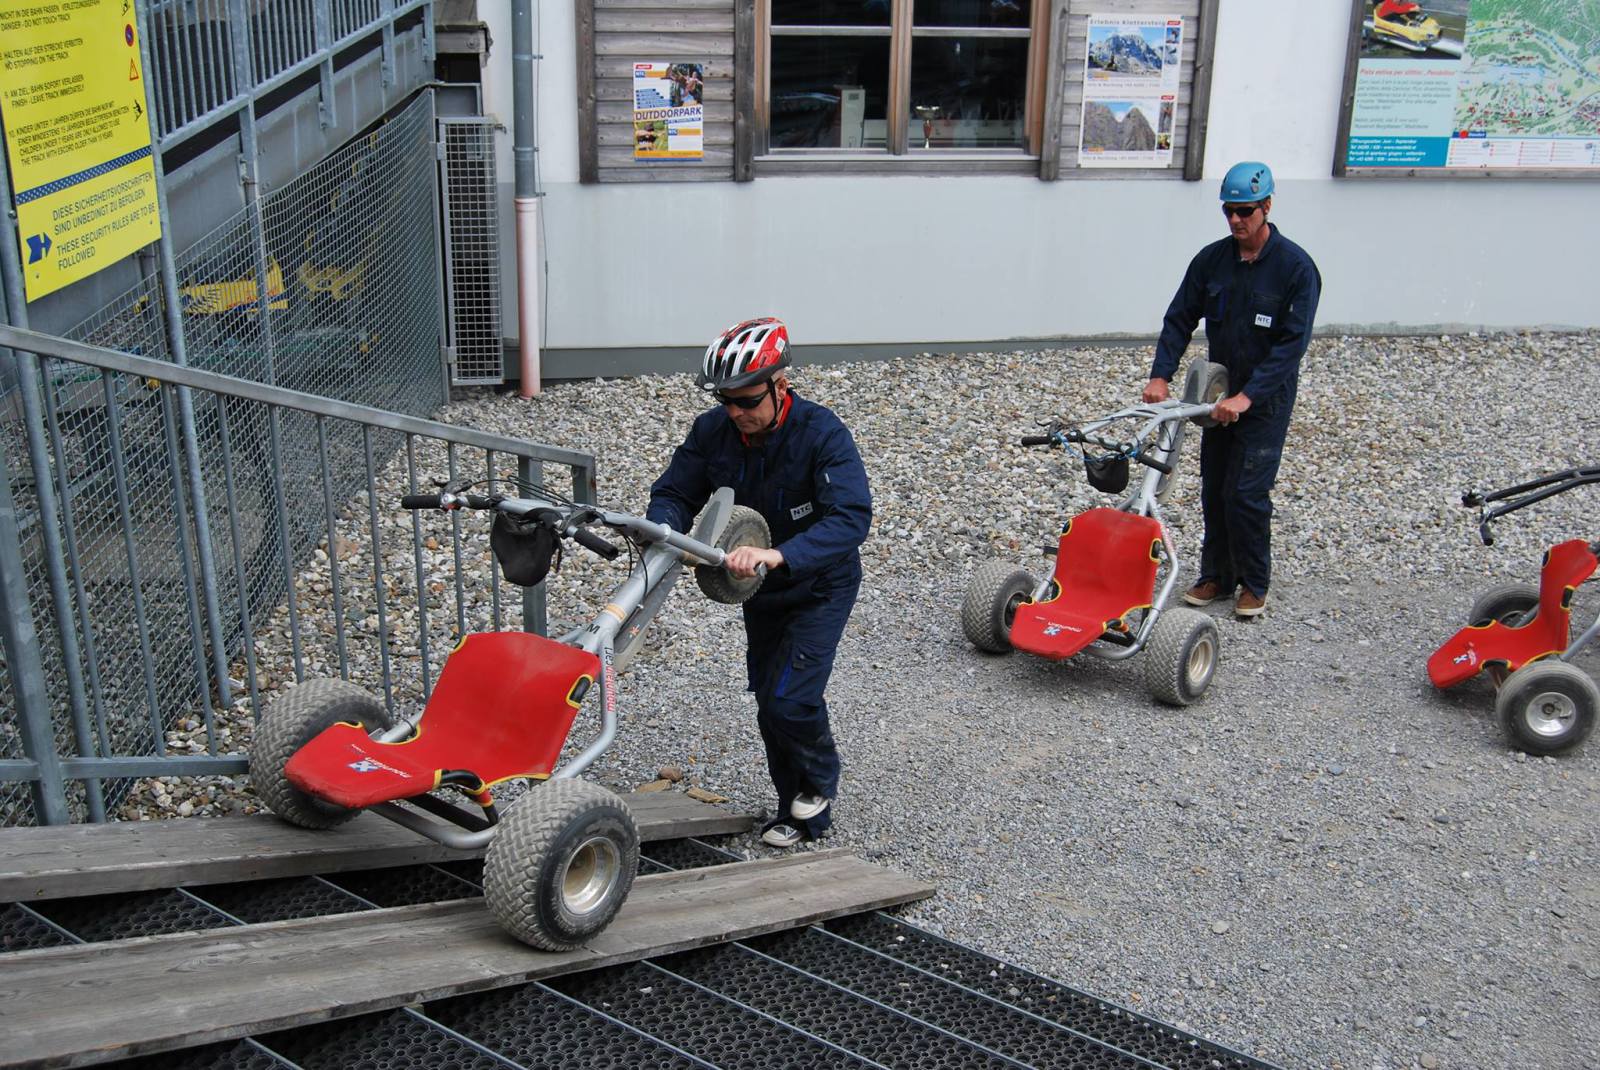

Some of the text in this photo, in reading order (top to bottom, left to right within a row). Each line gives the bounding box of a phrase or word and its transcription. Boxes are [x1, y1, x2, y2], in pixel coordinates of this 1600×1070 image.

[1, 20, 20, 31] DANGER
[636, 107, 702, 120] OUTDOORPARK
[52, 172, 153, 221] DIESE SICHERHEITSVORSCHRIFTEN
[54, 188, 146, 236] SIND UNBEDINGT ZU BEFOLGEN
[56, 202, 156, 258] THESE SECURITY RULES ARE TO BE
[58, 245, 96, 272] FOLLOWED
[794, 505, 809, 516] NTC
